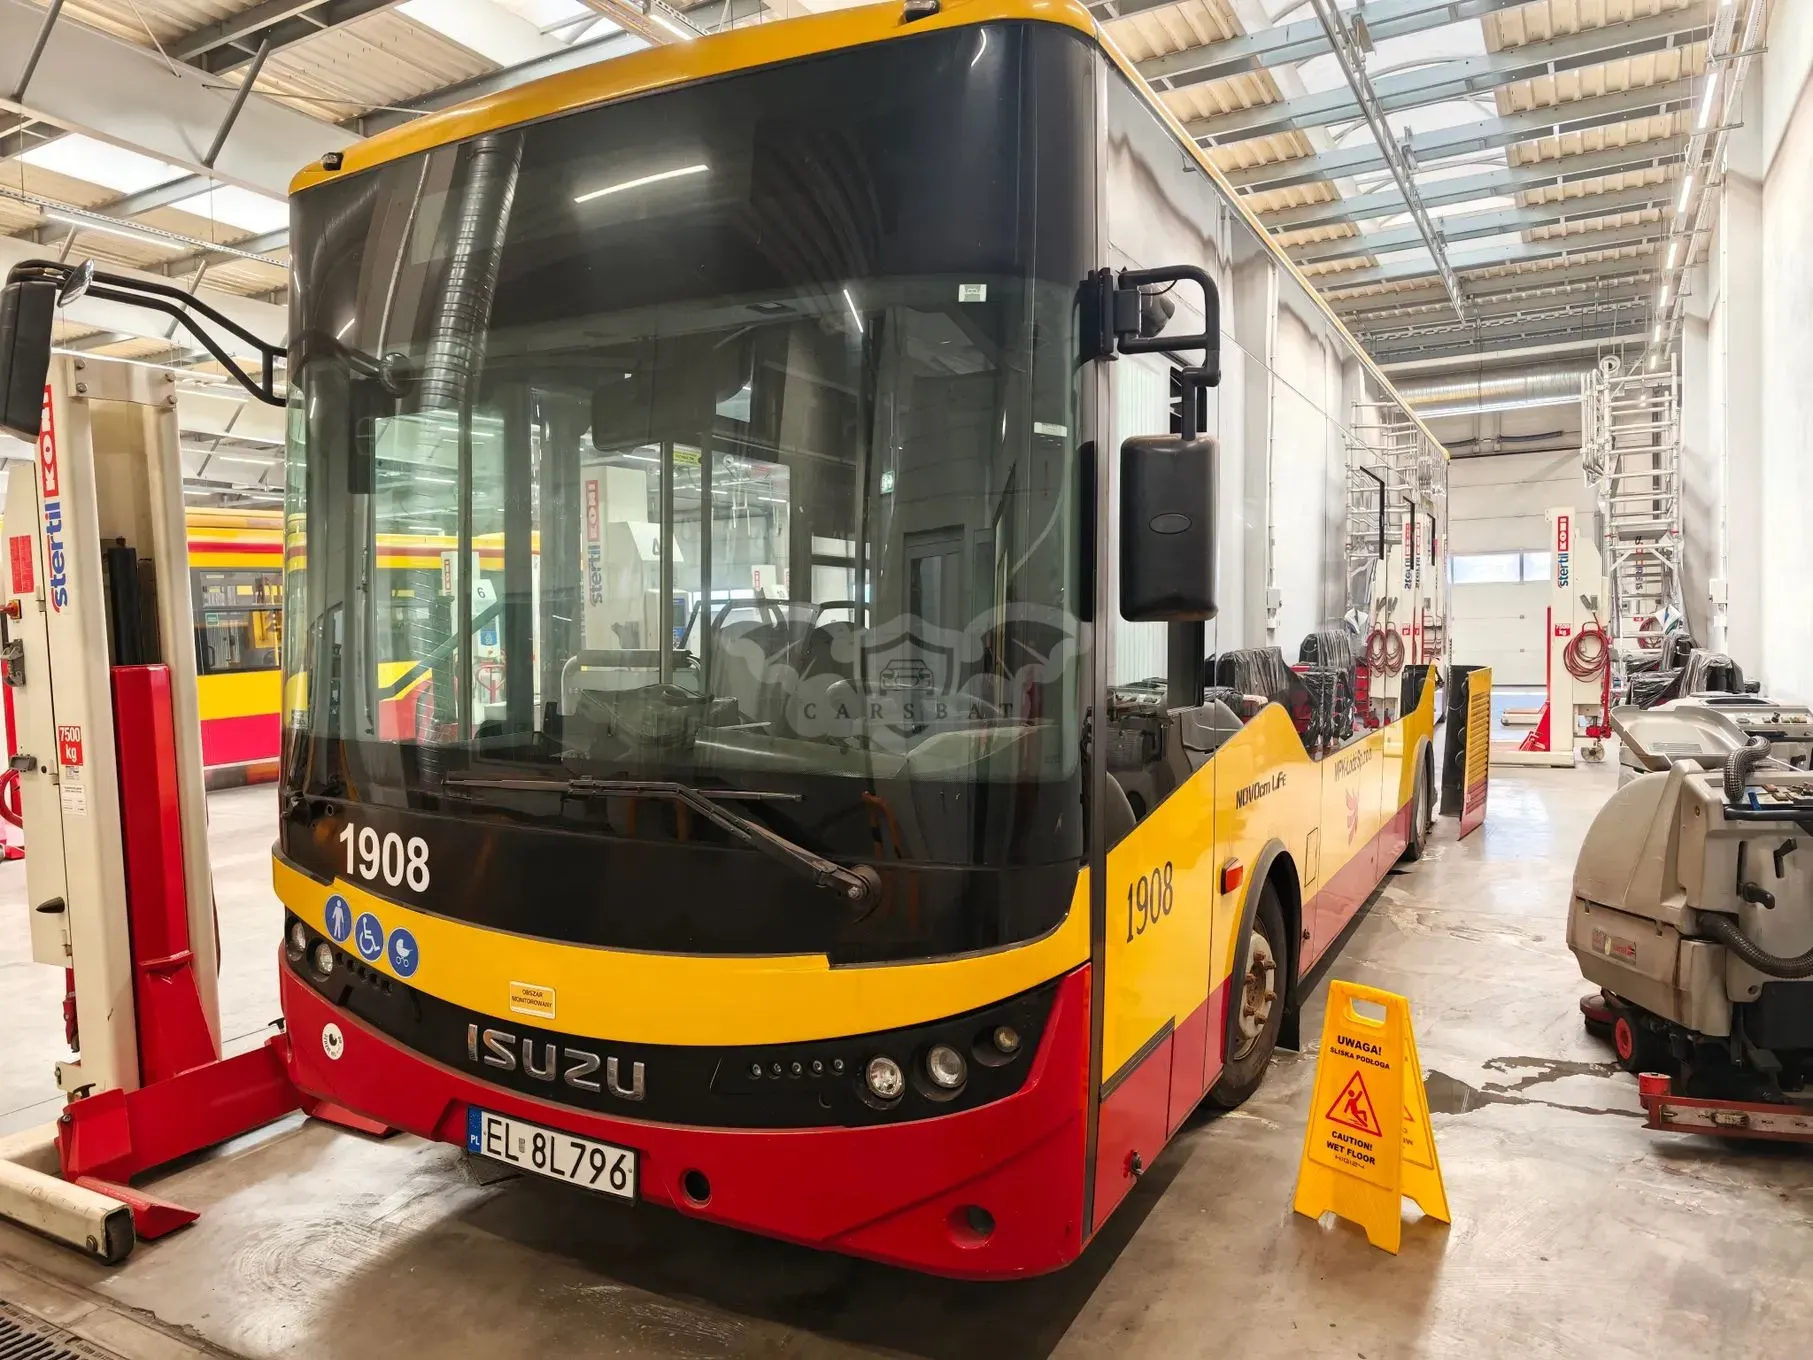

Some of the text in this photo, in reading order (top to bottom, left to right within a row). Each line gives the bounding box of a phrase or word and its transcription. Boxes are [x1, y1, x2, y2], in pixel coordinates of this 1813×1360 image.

[45, 502, 67, 612] stertil
[588, 545, 602, 607] stertil
[1558, 553, 1568, 588] stertil
[477, 587, 486, 599] 6
[60, 727, 80, 742] 7500
[65, 744, 77, 763] kg
[340, 822, 430, 893] 1908
[1126, 861, 1173, 944] 1908
[512, 995, 552, 1007] MONITOROWANY
[522, 989, 543, 998] OBSZAR
[1337, 1035, 1382, 1056] UWAGA!
[468, 1024, 645, 1100] ISUZU
[470, 1134, 480, 1146] PL
[1331, 1130, 1373, 1151] CAUTION!
[487, 1117, 627, 1190] EL 8L796
[1326, 1140, 1344, 1153] WET
[1346, 1148, 1376, 1165] FLOOR
